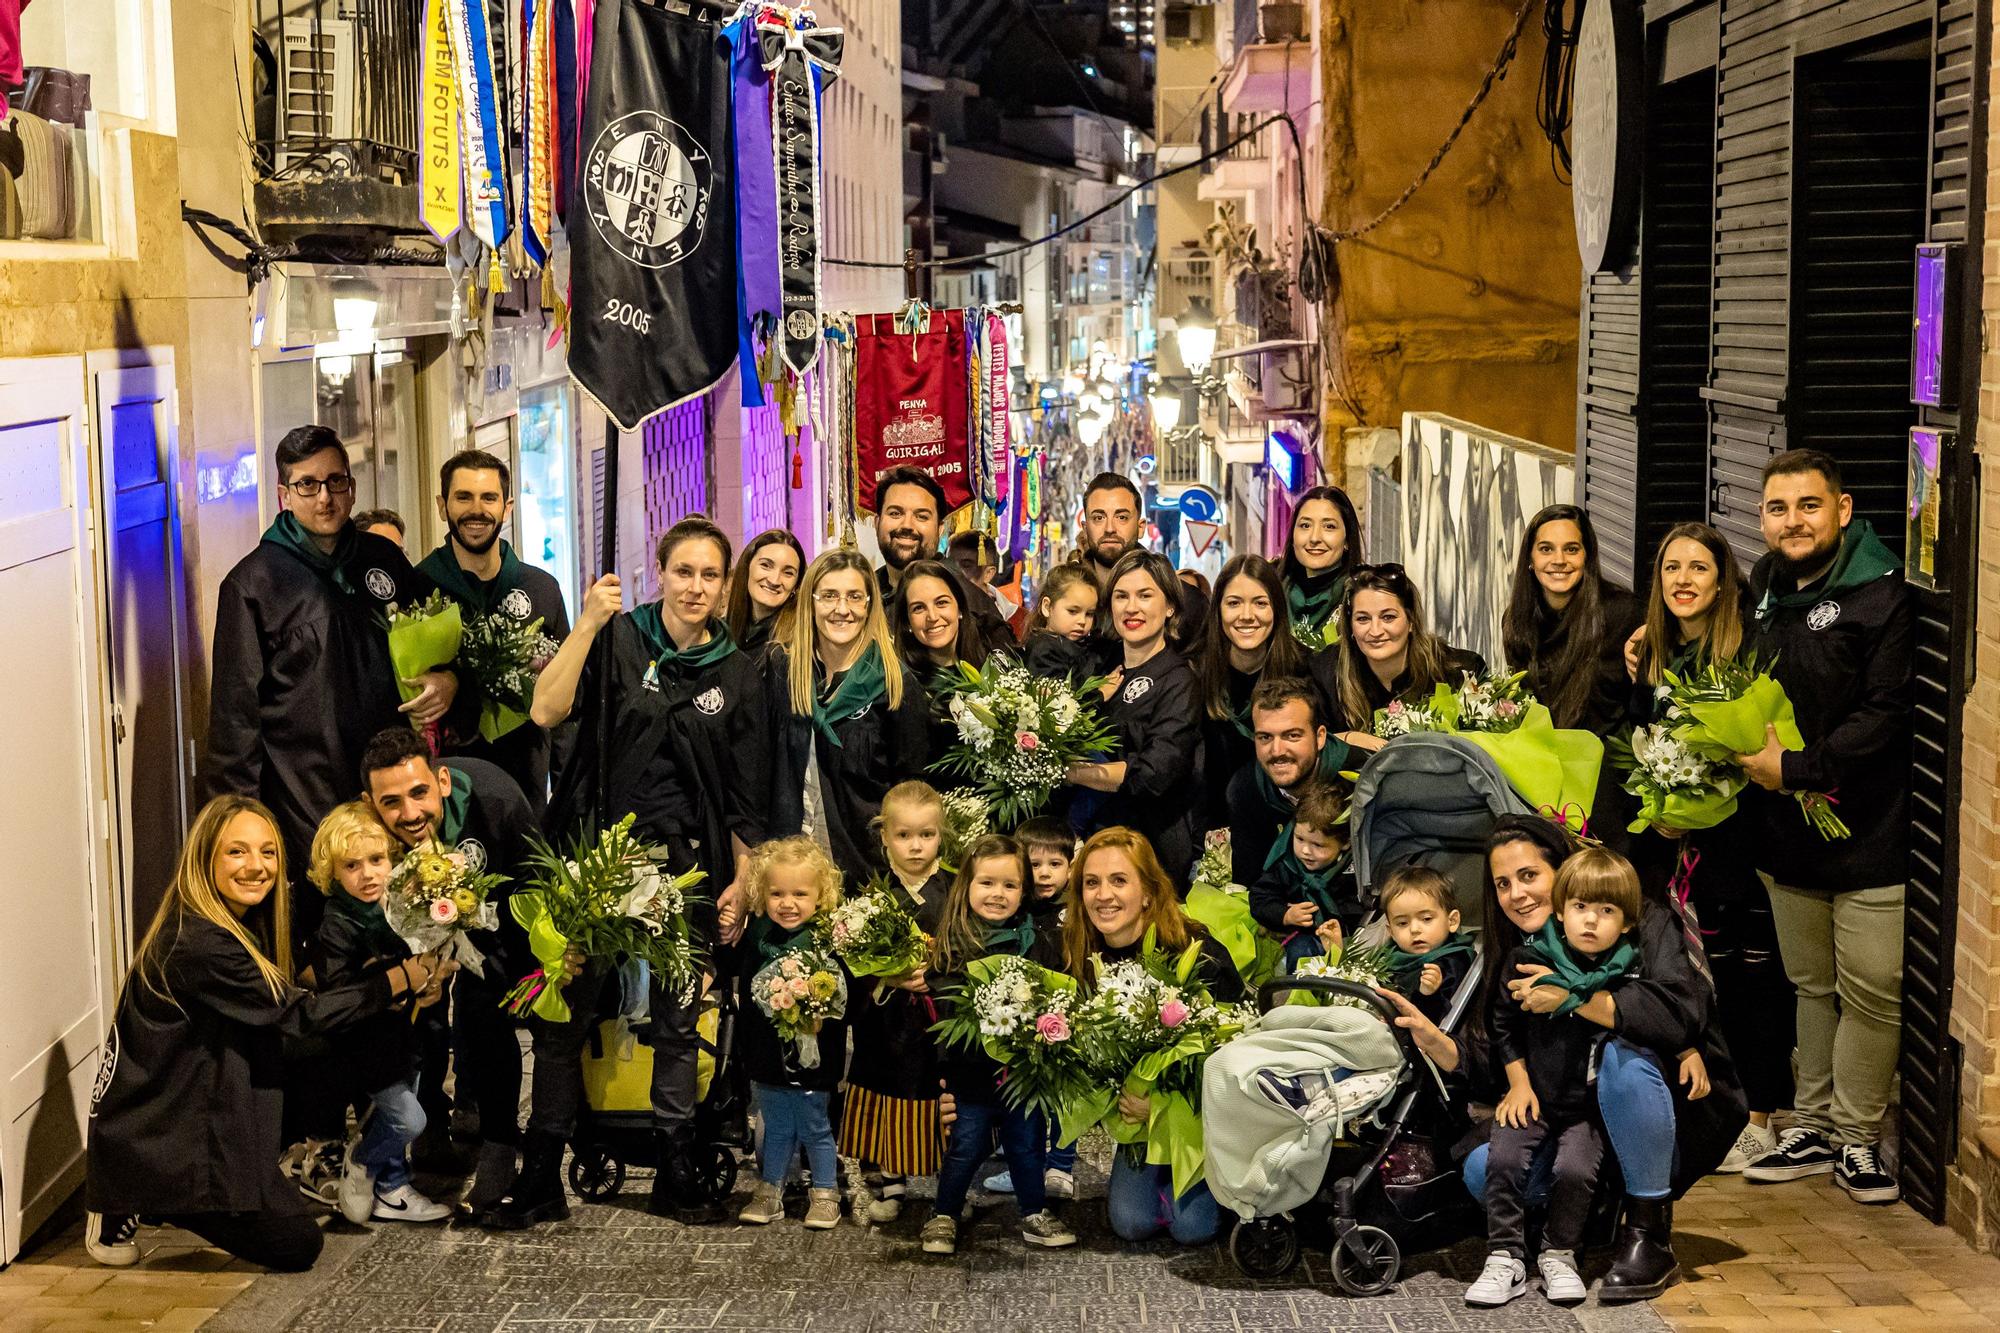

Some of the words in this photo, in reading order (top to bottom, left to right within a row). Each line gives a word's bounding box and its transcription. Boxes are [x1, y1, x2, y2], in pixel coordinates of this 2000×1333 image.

[784, 80, 807, 125] Enlace
[433, 83, 449, 169] FOTUTS
[786, 127, 811, 195] Samantha
[784, 213, 812, 270] Rodrigo
[603, 298, 652, 335] 2005
[992, 343, 1005, 372] FESTES
[899, 399, 927, 410] PENYA
[992, 374, 1005, 408] MAJORS
